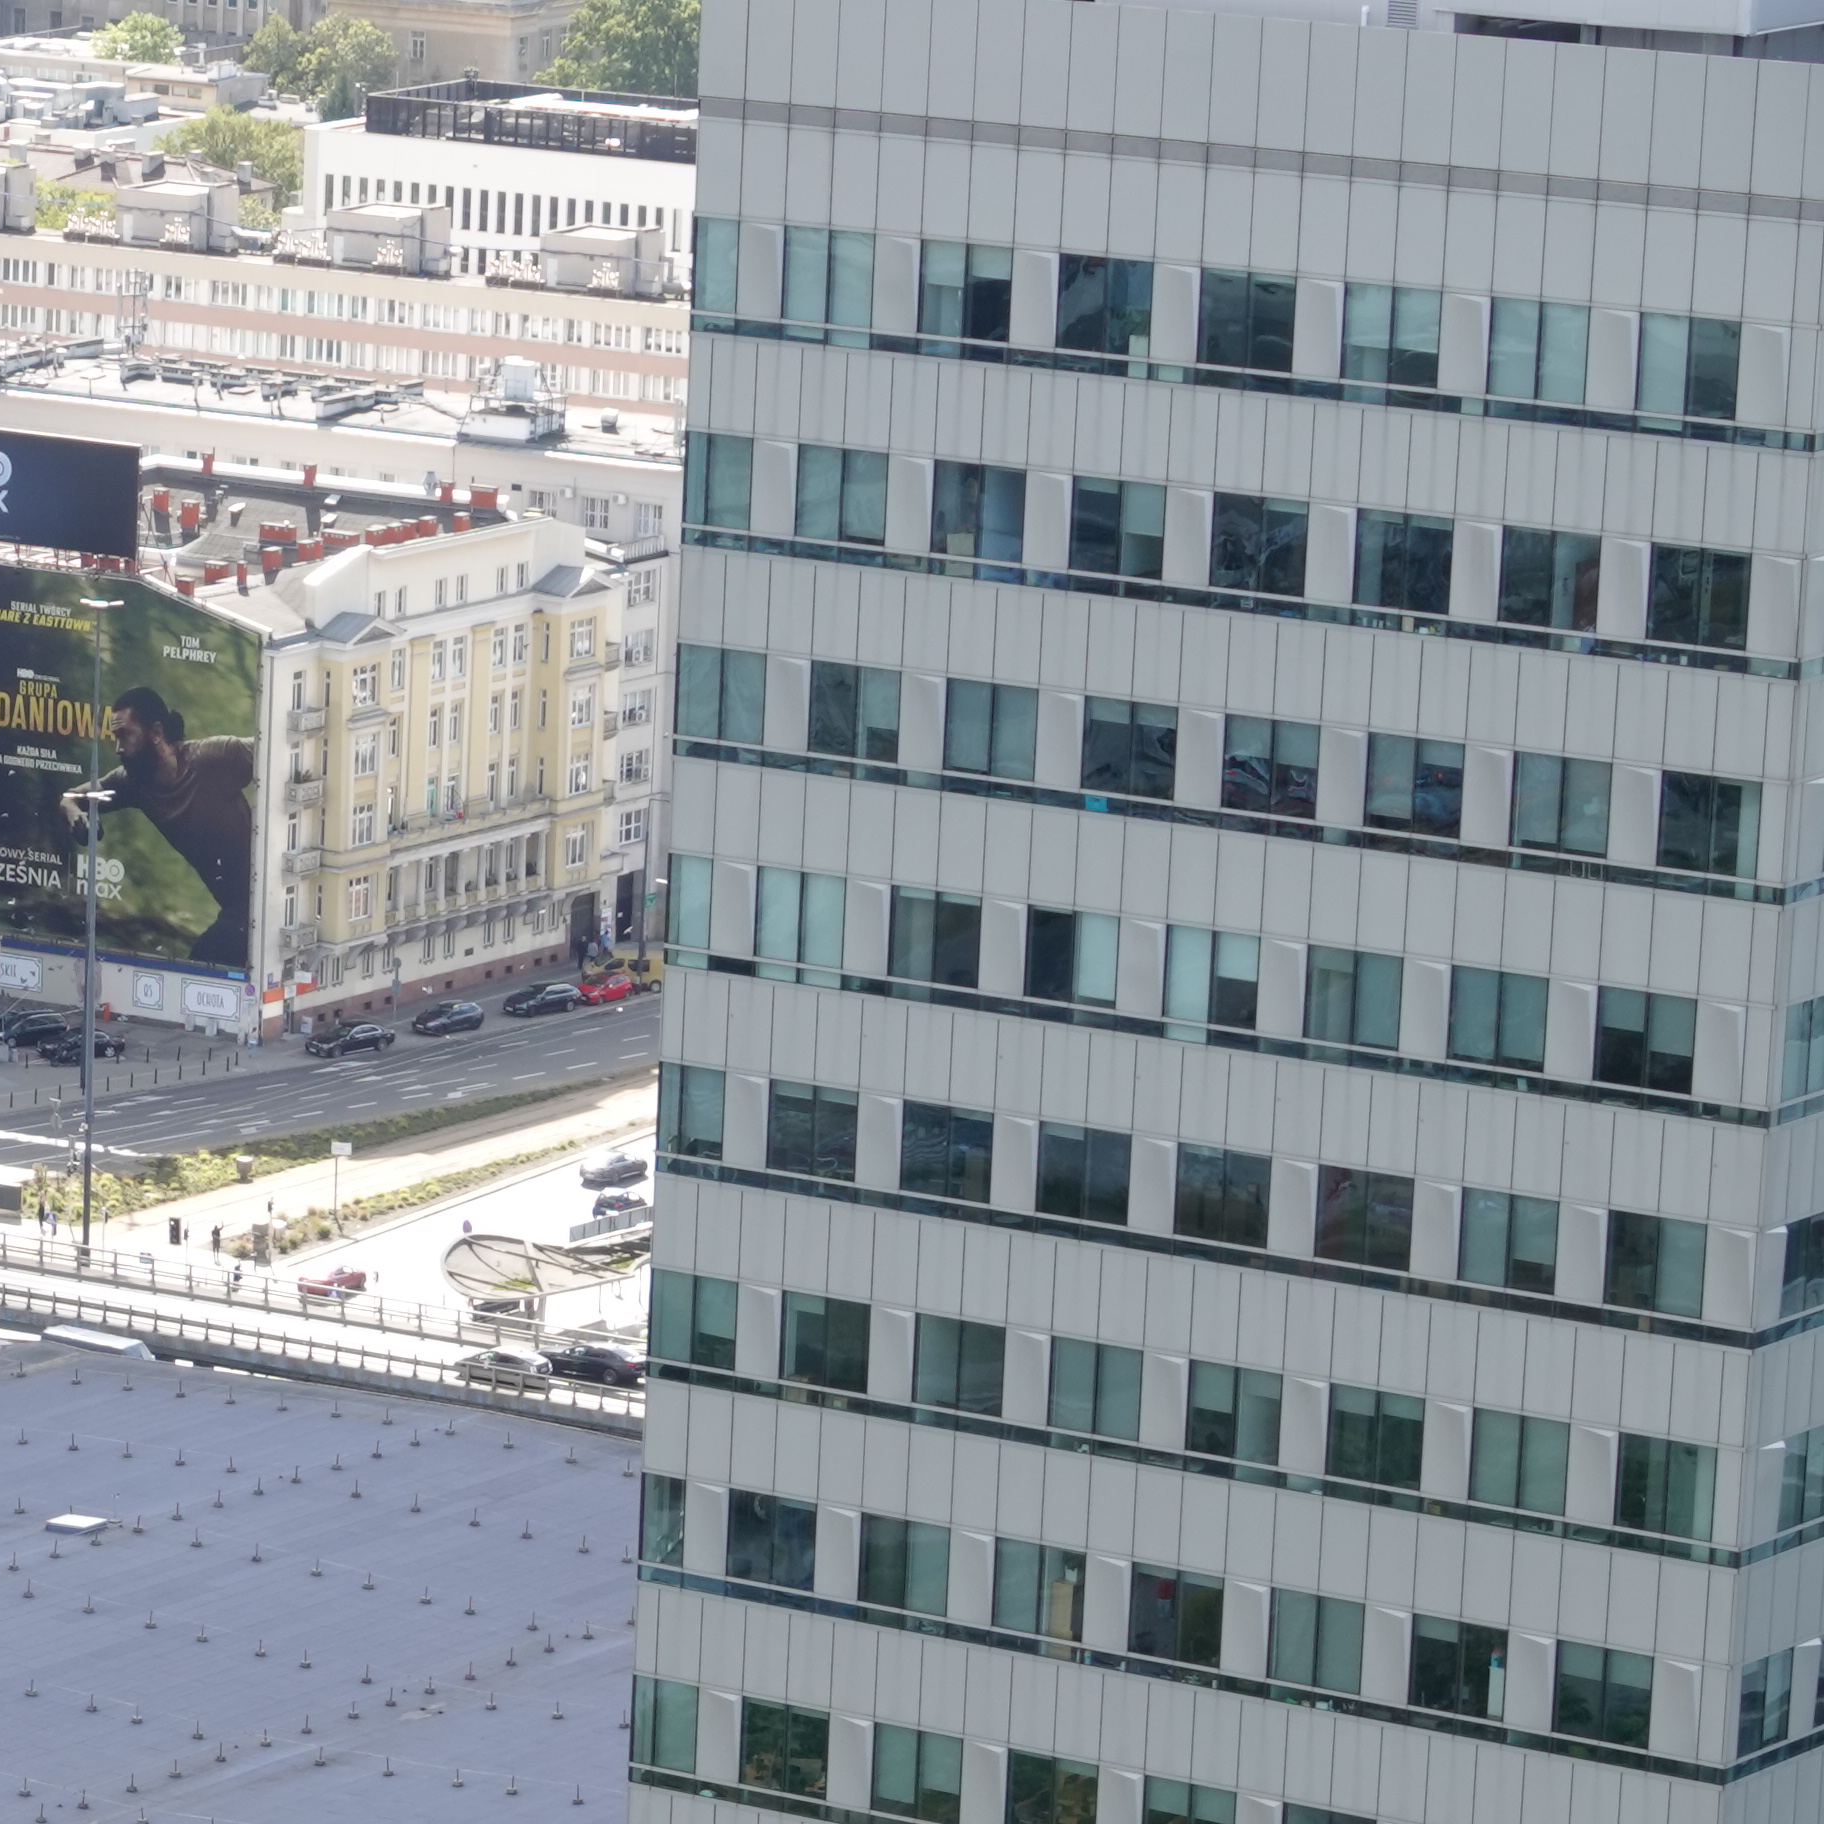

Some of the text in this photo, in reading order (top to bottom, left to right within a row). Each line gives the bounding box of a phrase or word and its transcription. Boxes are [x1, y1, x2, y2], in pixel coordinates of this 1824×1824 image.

[10, 601, 72, 617] SERIAL TWÓRCY
[22, 613, 31, 625] Z
[180, 635, 200, 649] TOM
[163, 645, 217, 664] PELPHREY
[19, 679, 58, 699] GRUPA
[27, 848, 63, 865] SERIAL
[76, 853, 125, 883] HBO
